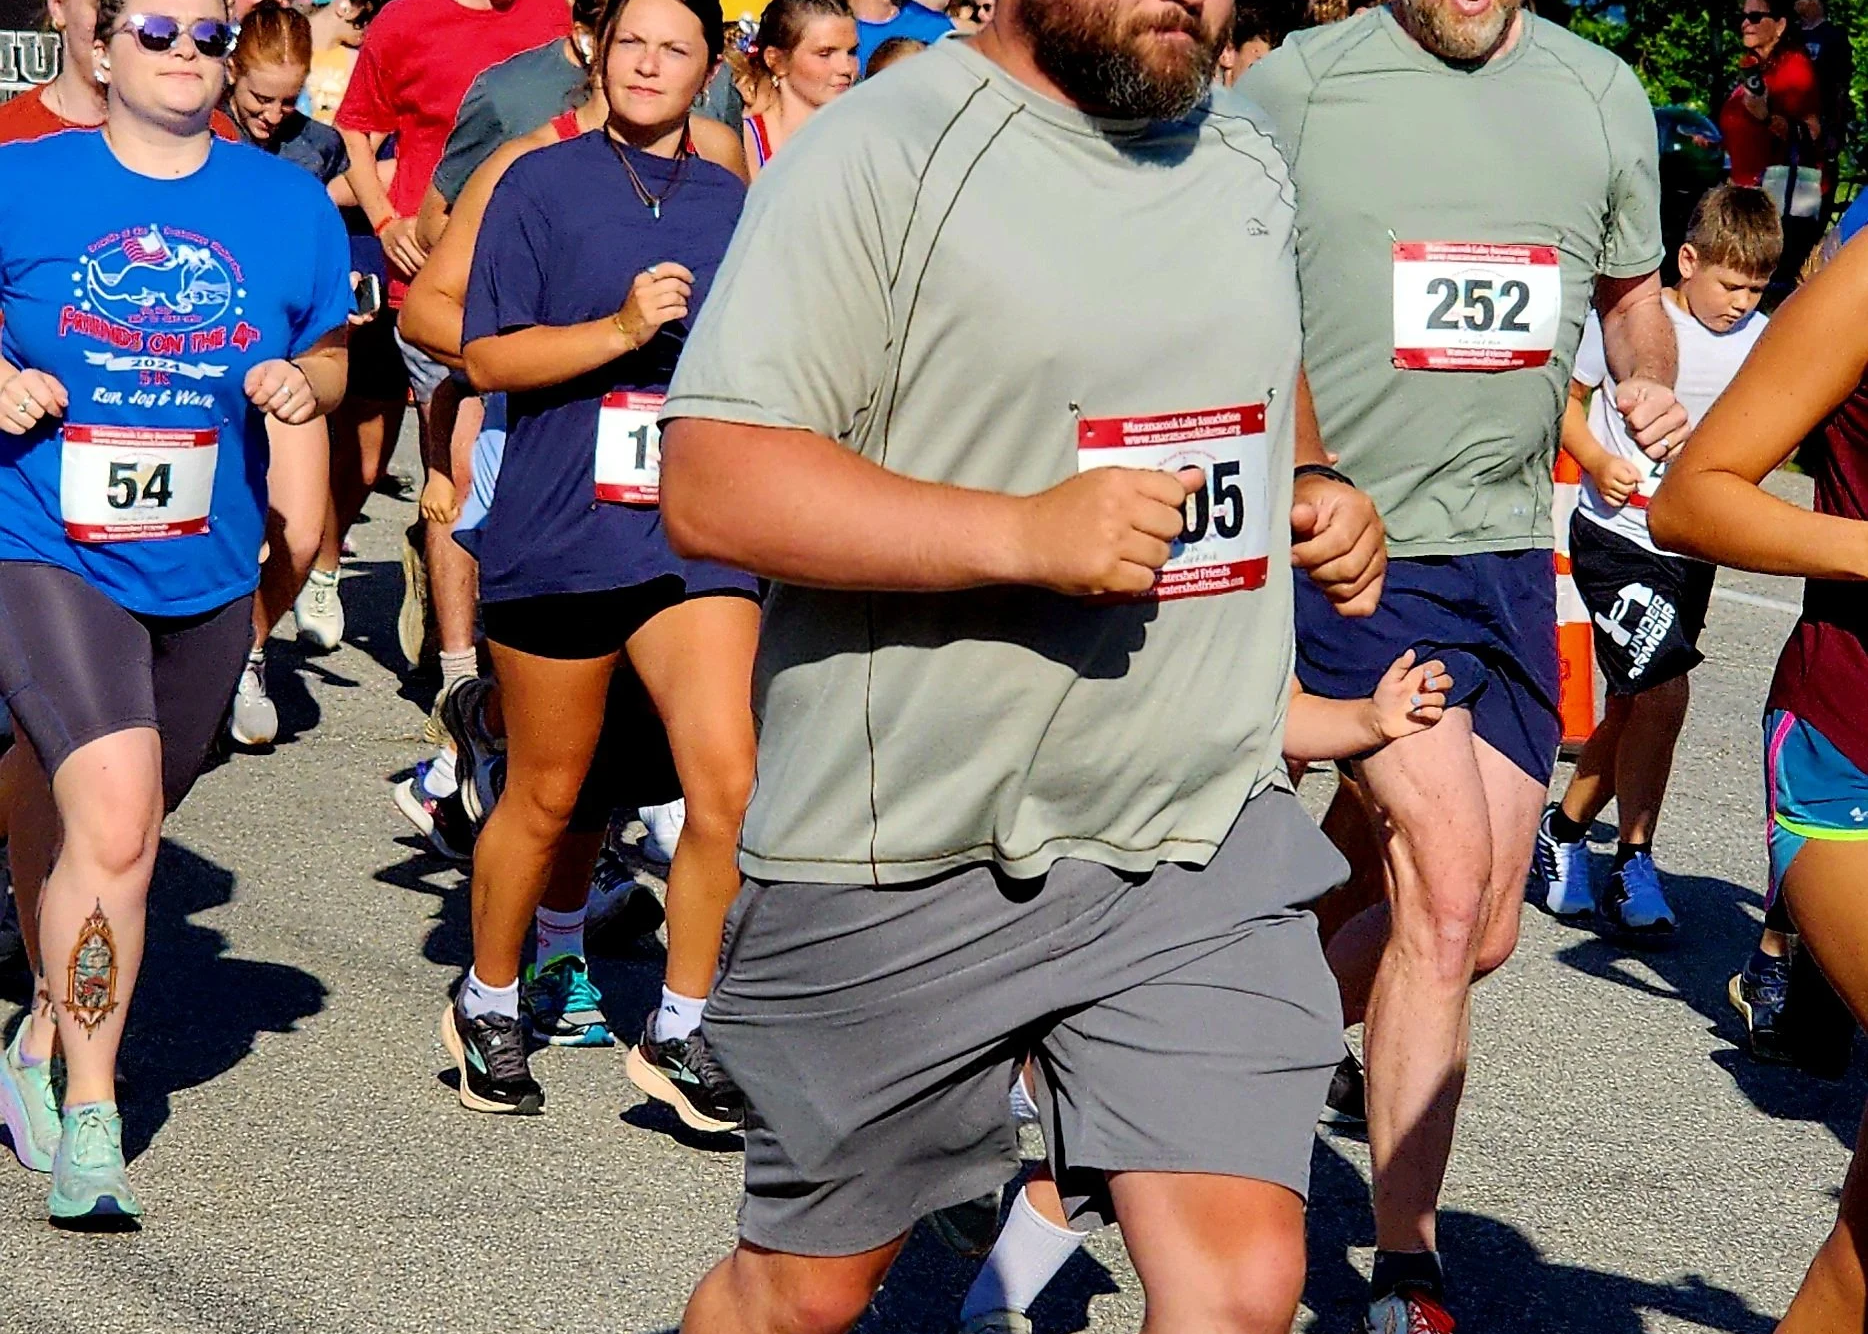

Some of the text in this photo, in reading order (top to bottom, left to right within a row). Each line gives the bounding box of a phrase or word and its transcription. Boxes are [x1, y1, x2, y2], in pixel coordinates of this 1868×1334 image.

[1426, 277, 1531, 333] 252
[148, 332, 185, 355] ON
[190, 326, 227, 354] THE
[131, 358, 181, 372] 2024
[128, 389, 156, 408] Jog
[175, 389, 215, 409] Walk
[107, 461, 173, 509] 54
[1176, 460, 1244, 544] 05
[1627, 594, 1676, 680] UNDER ARMOUR
